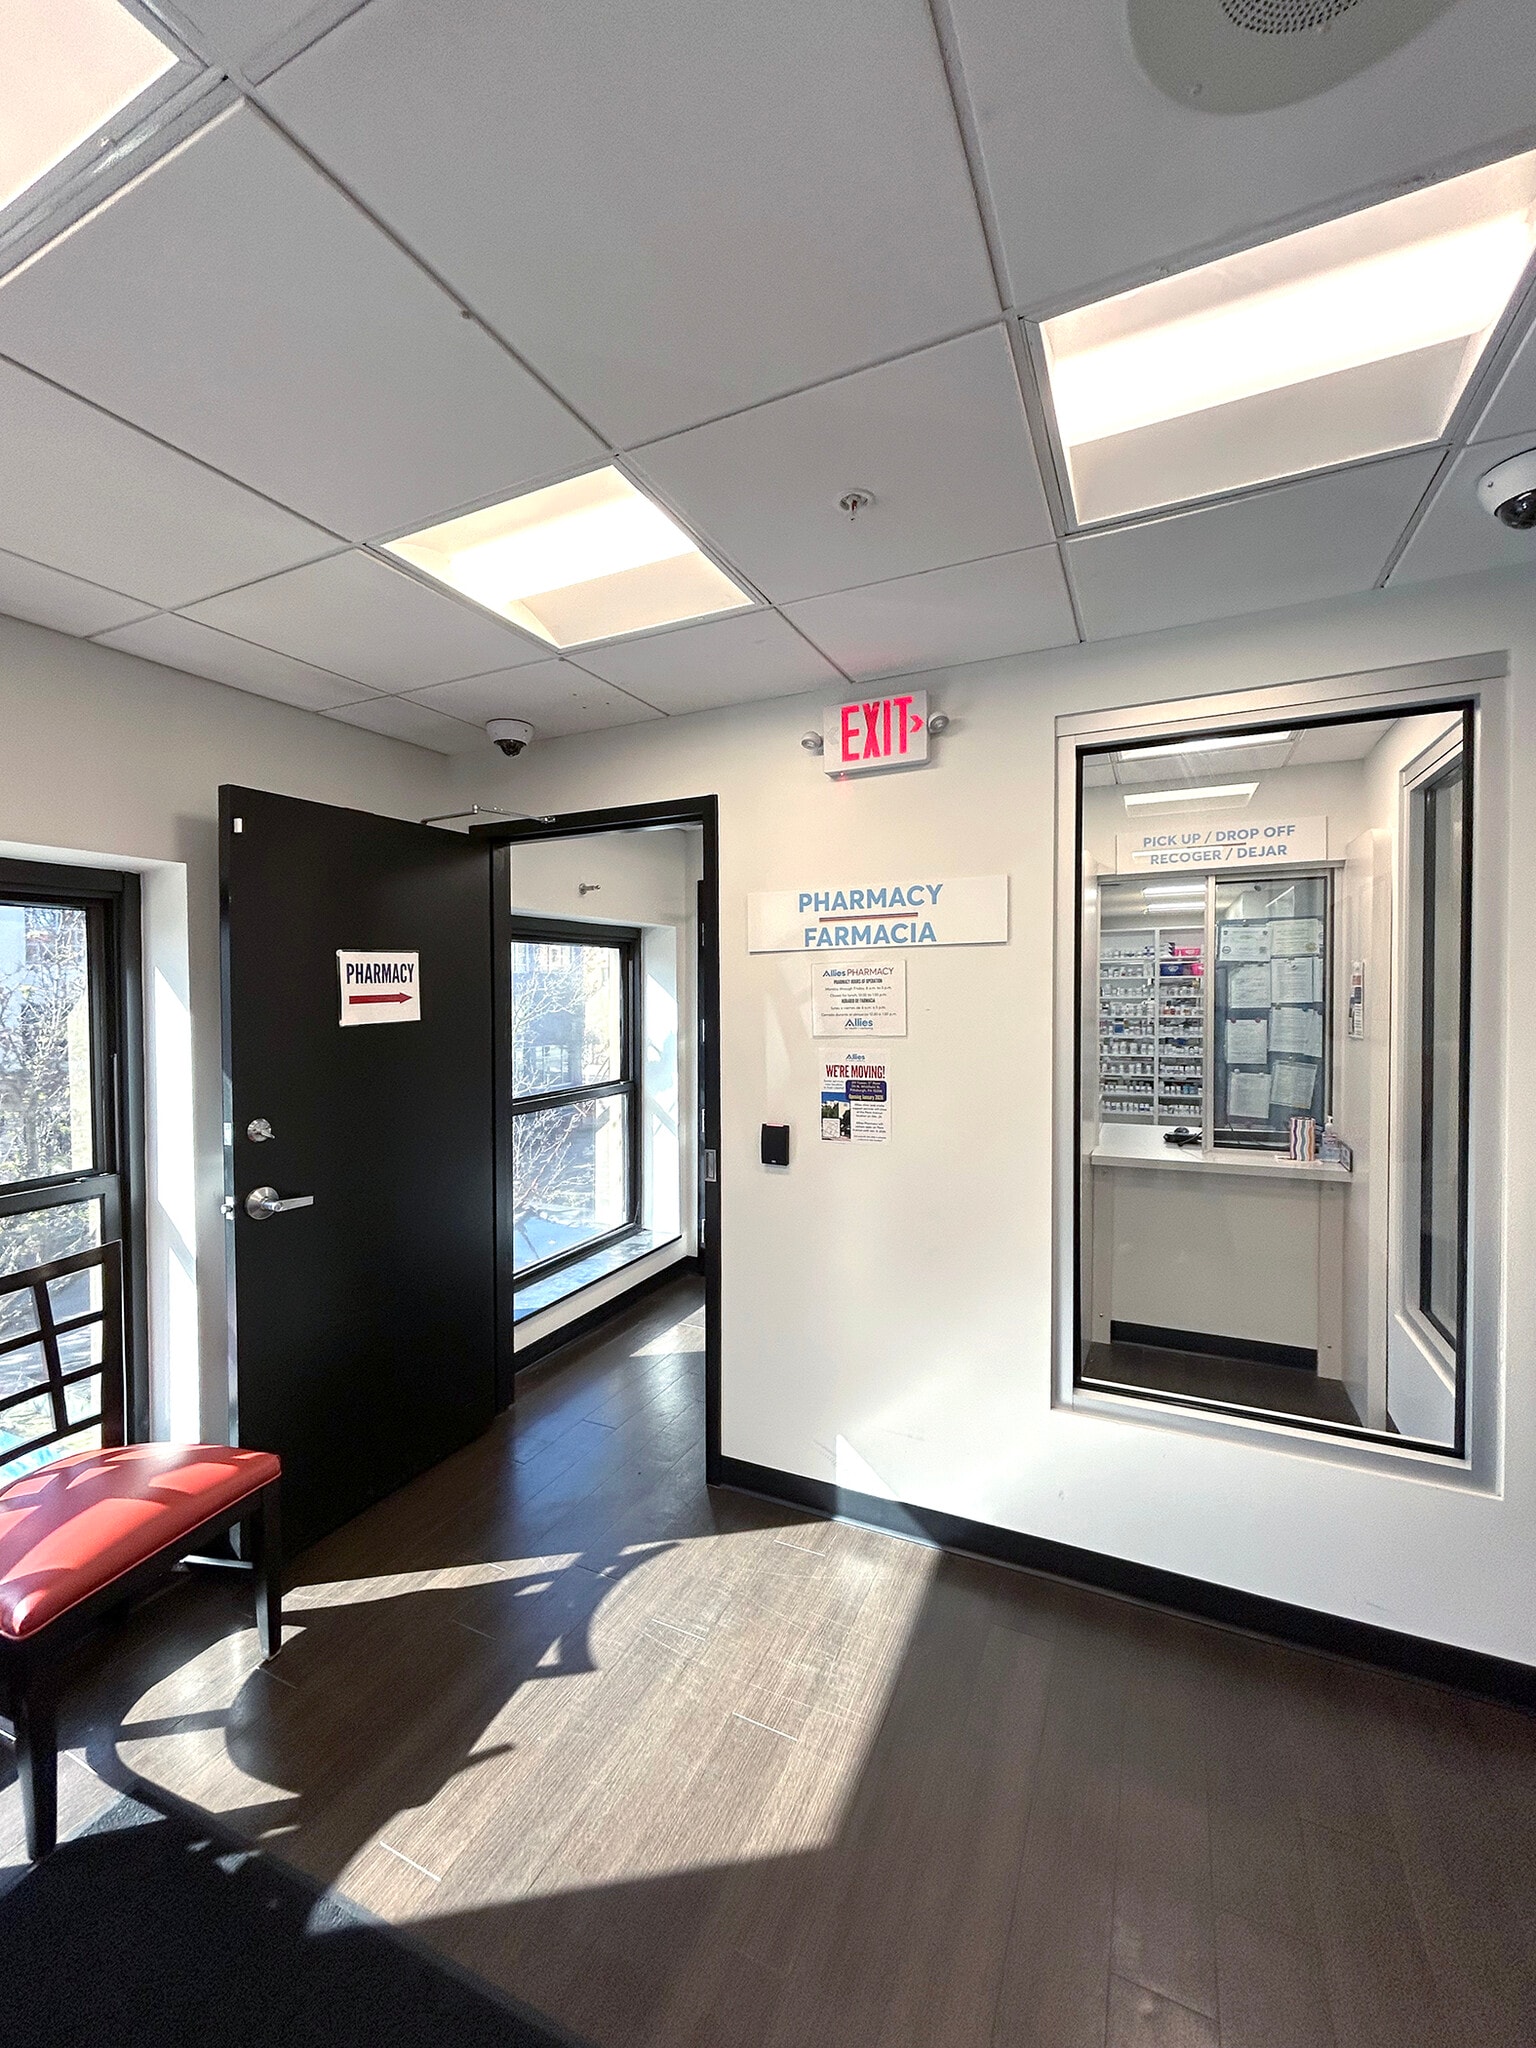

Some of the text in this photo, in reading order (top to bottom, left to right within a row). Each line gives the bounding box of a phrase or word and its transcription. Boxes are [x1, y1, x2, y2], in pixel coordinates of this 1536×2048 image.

[841, 696, 913, 762] EXIT
[1143, 825, 1296, 848] PICK UP / DROP OFF
[1150, 844, 1287, 865] RECOGER / DEJAR
[798, 884, 943, 913] PHARMACY
[804, 922, 937, 947] FARMACIA
[346, 963, 415, 984] PHARMACY
[822, 967, 894, 978] Allies PHARMACY
[845, 1018, 873, 1027] Allies
[825, 1064, 886, 1079] WE'RE MOVING!
